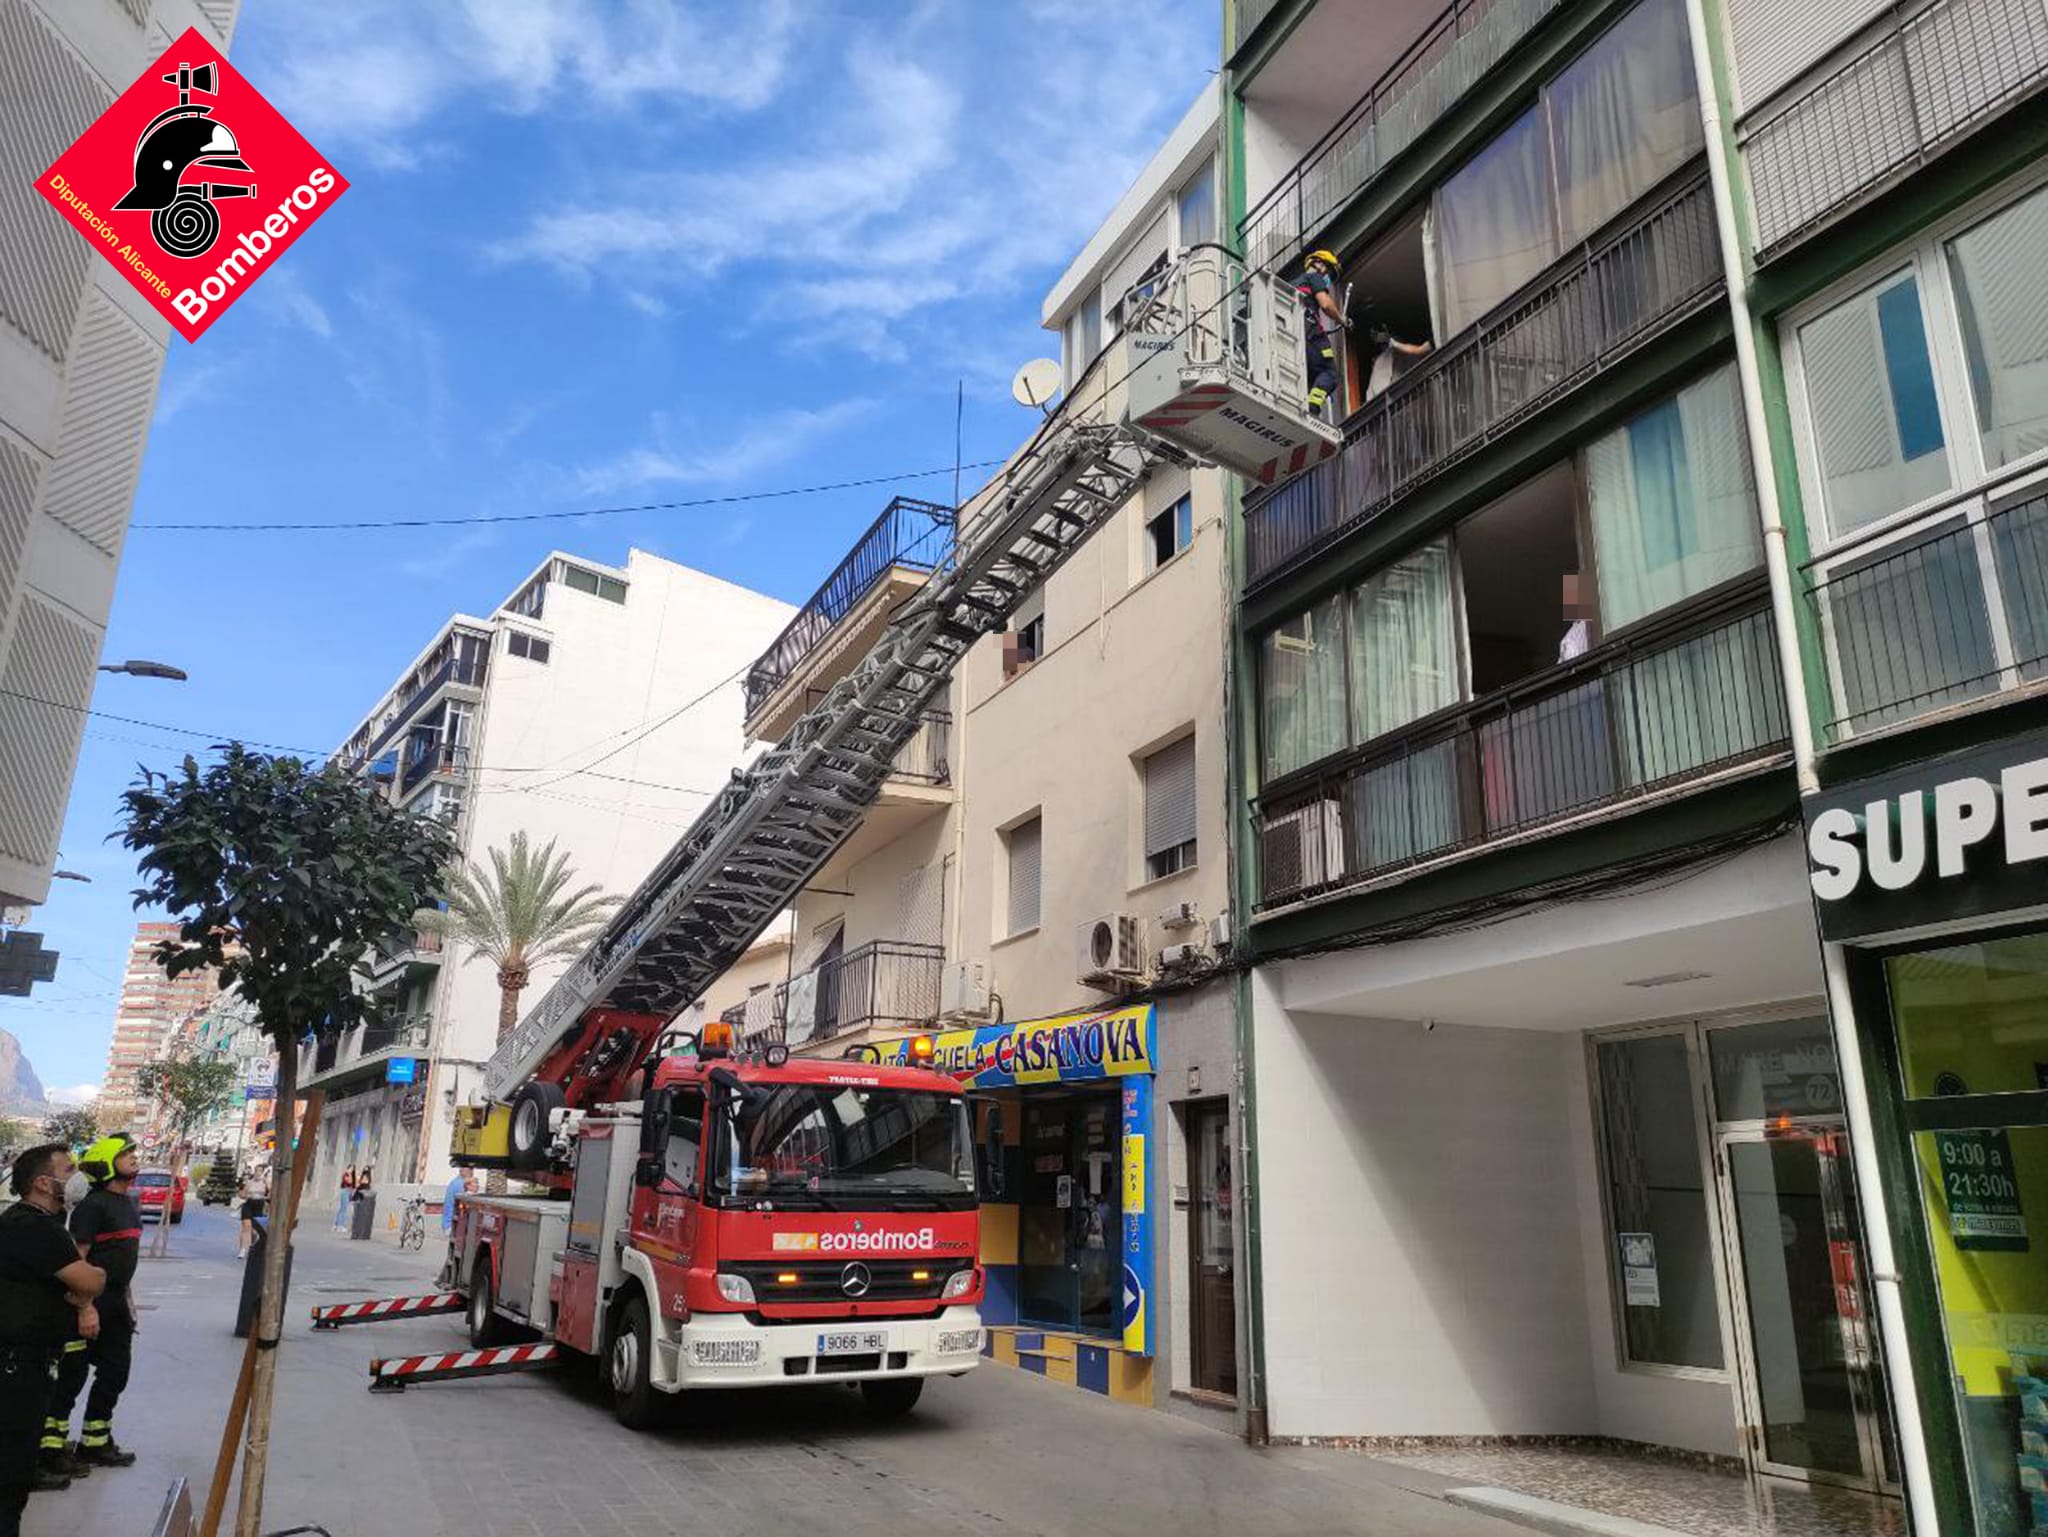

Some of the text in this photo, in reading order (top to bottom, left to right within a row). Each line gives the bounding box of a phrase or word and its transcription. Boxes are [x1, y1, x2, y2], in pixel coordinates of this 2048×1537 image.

[1134, 339, 1176, 351] MAGIRUS
[1219, 407, 1296, 448] MAGIRUS
[1809, 757, 2048, 900] SUPE
[994, 1017, 1145, 1075] CASANOVA
[1809, 1084, 1830, 1101] 72
[1943, 1141, 2002, 1166] 9:00 a
[1950, 1172, 2015, 1198] 21:30h
[827, 1333, 884, 1349] 9066 HBL
